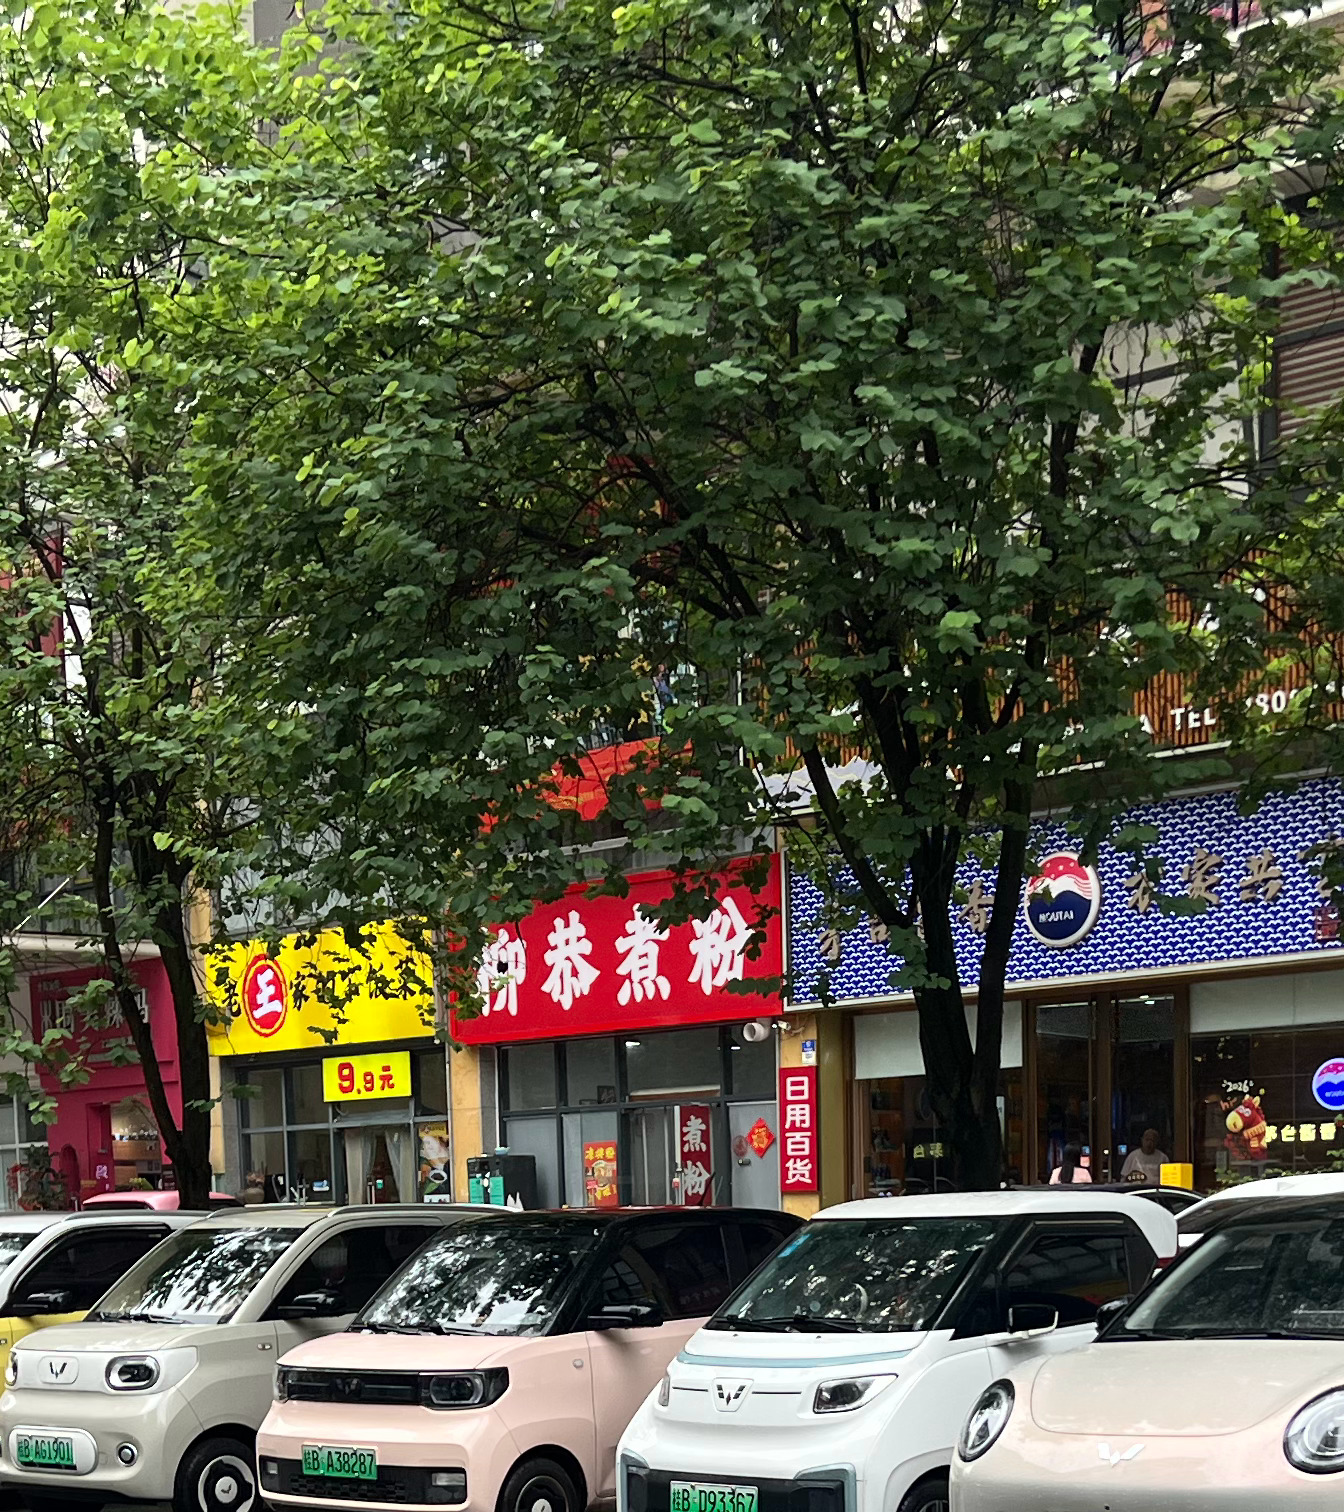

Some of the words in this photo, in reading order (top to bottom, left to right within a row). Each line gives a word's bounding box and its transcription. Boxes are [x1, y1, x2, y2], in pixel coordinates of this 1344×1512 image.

[474, 896, 756, 1017] 柳恭煮粉
[337, 1061, 395, 1094] 9.9元
[682, 1114, 711, 1197] 煮粉
[784, 1075, 813, 1185] 日用百货
